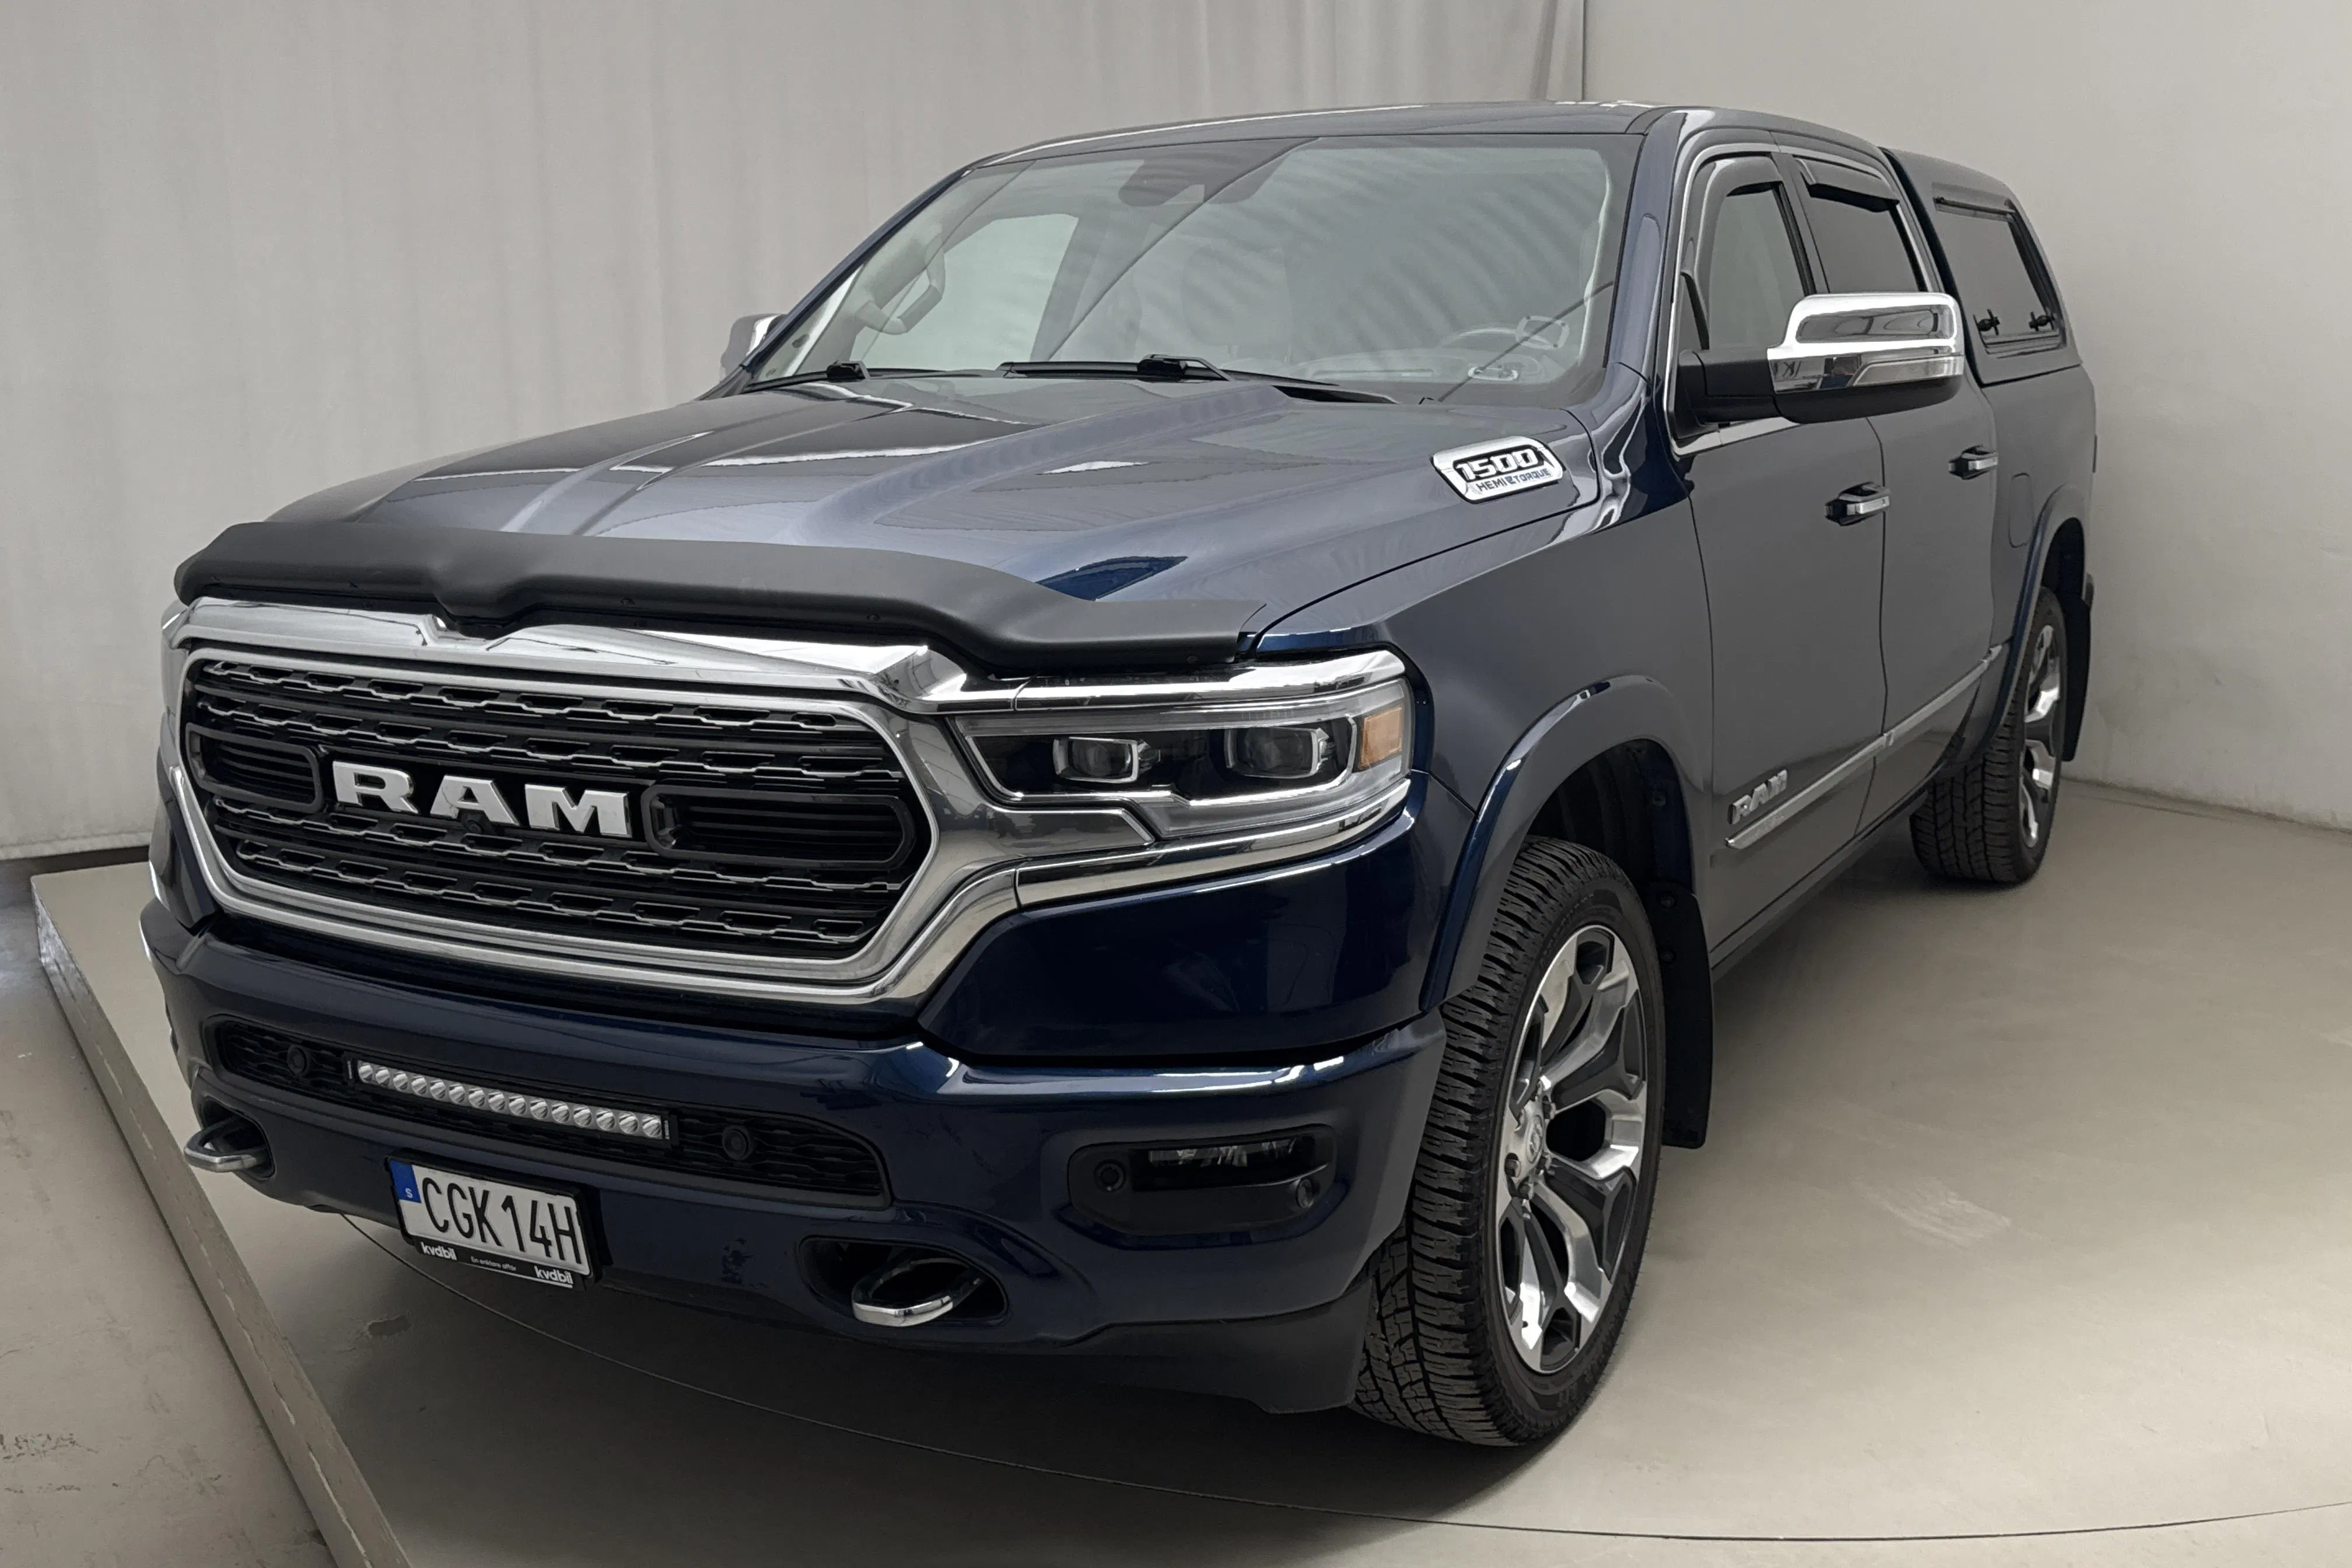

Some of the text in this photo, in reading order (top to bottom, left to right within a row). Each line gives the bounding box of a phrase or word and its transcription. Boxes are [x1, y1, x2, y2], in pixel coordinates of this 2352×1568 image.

[1456, 447, 1539, 481] 1500
[1475, 477, 1508, 492] HEMI
[332, 760, 632, 838] RAM
[1727, 769, 1788, 825] RAM
[405, 1188, 414, 1199] S
[422, 1177, 582, 1265] CGK 14H
[421, 1241, 457, 1261] kvdbil
[534, 1265, 573, 1284] kvdbil
